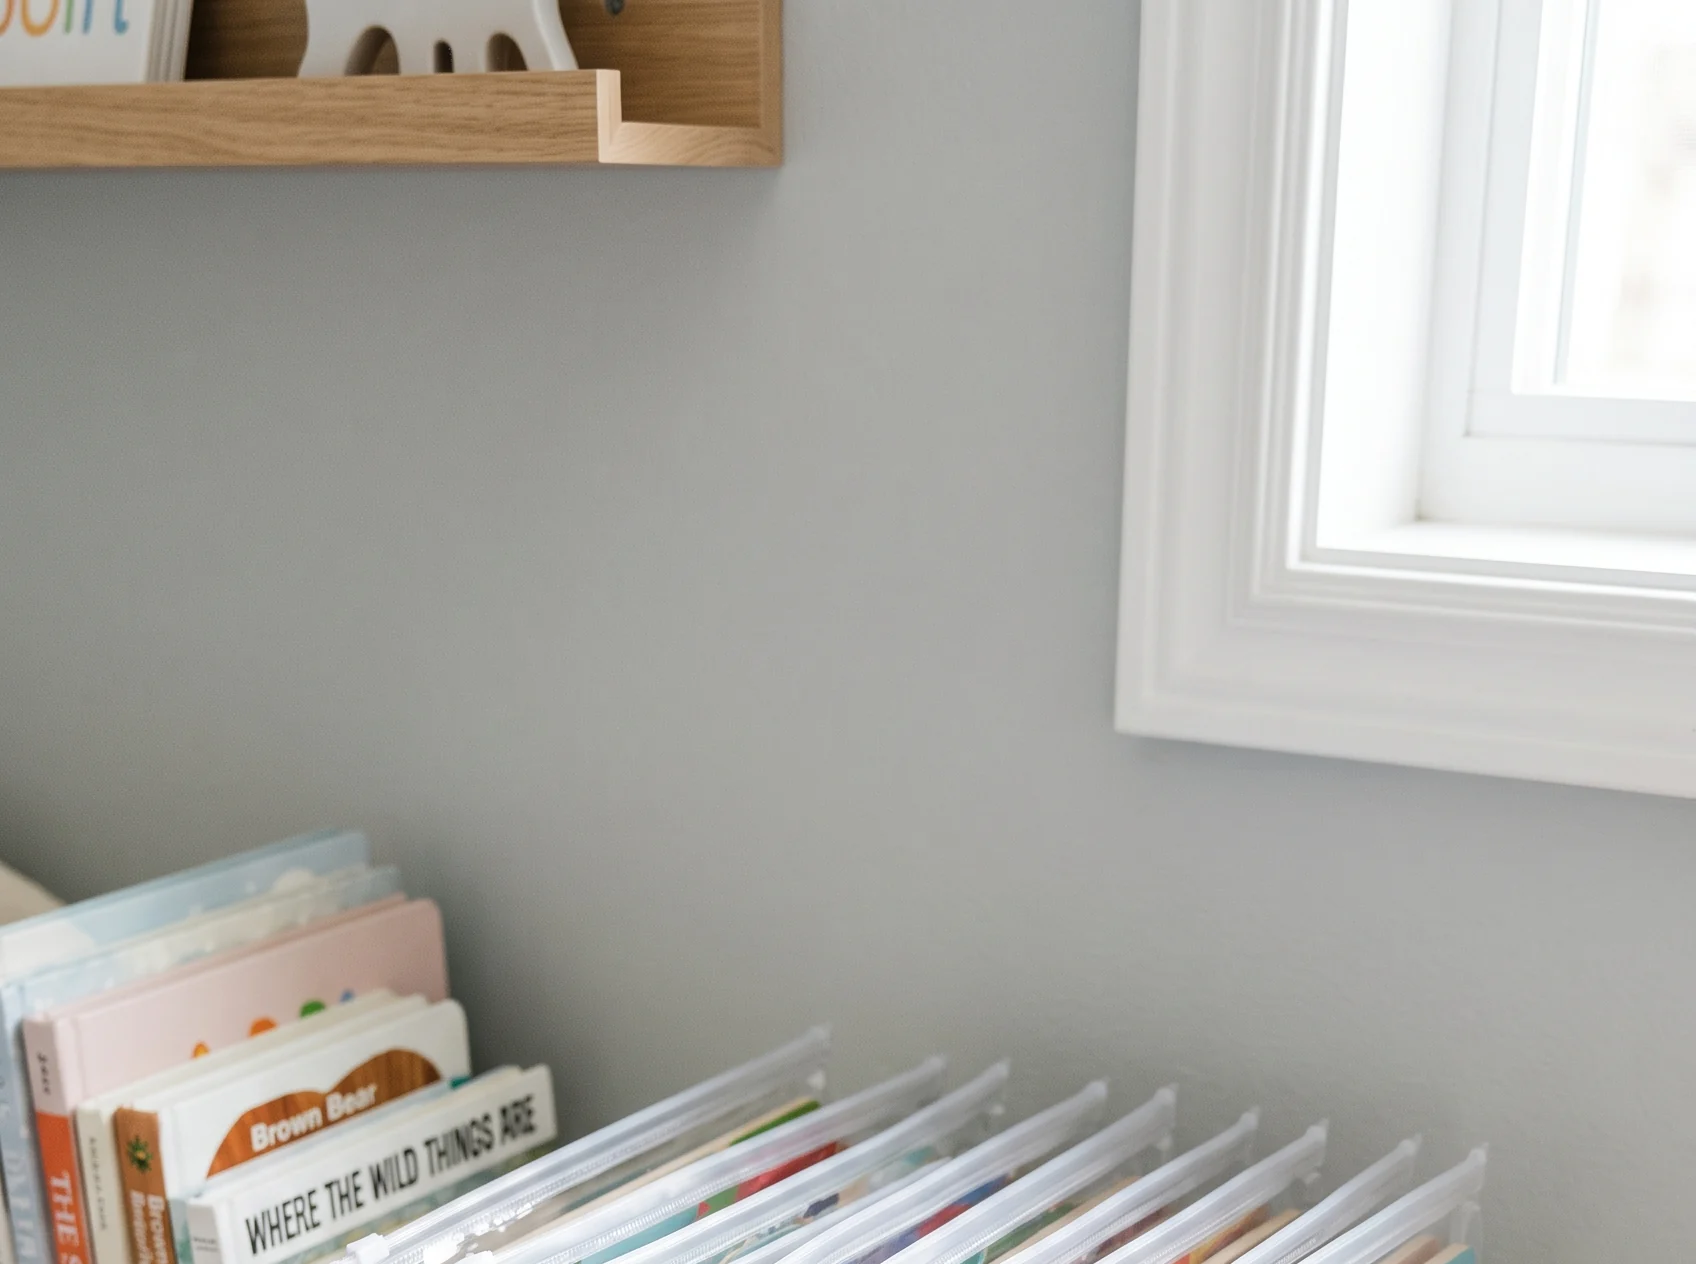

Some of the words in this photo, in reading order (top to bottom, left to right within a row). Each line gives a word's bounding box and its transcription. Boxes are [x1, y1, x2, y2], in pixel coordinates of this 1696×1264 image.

[250, 1106, 323, 1152] Brown
[326, 1083, 378, 1121] Bear
[50, 1169, 80, 1247] THE
[246, 1188, 321, 1255] WHERE
[325, 1170, 364, 1220] THE
[368, 1148, 419, 1200] WILD
[423, 1112, 495, 1176] THINGS
[499, 1095, 537, 1144] ARE
